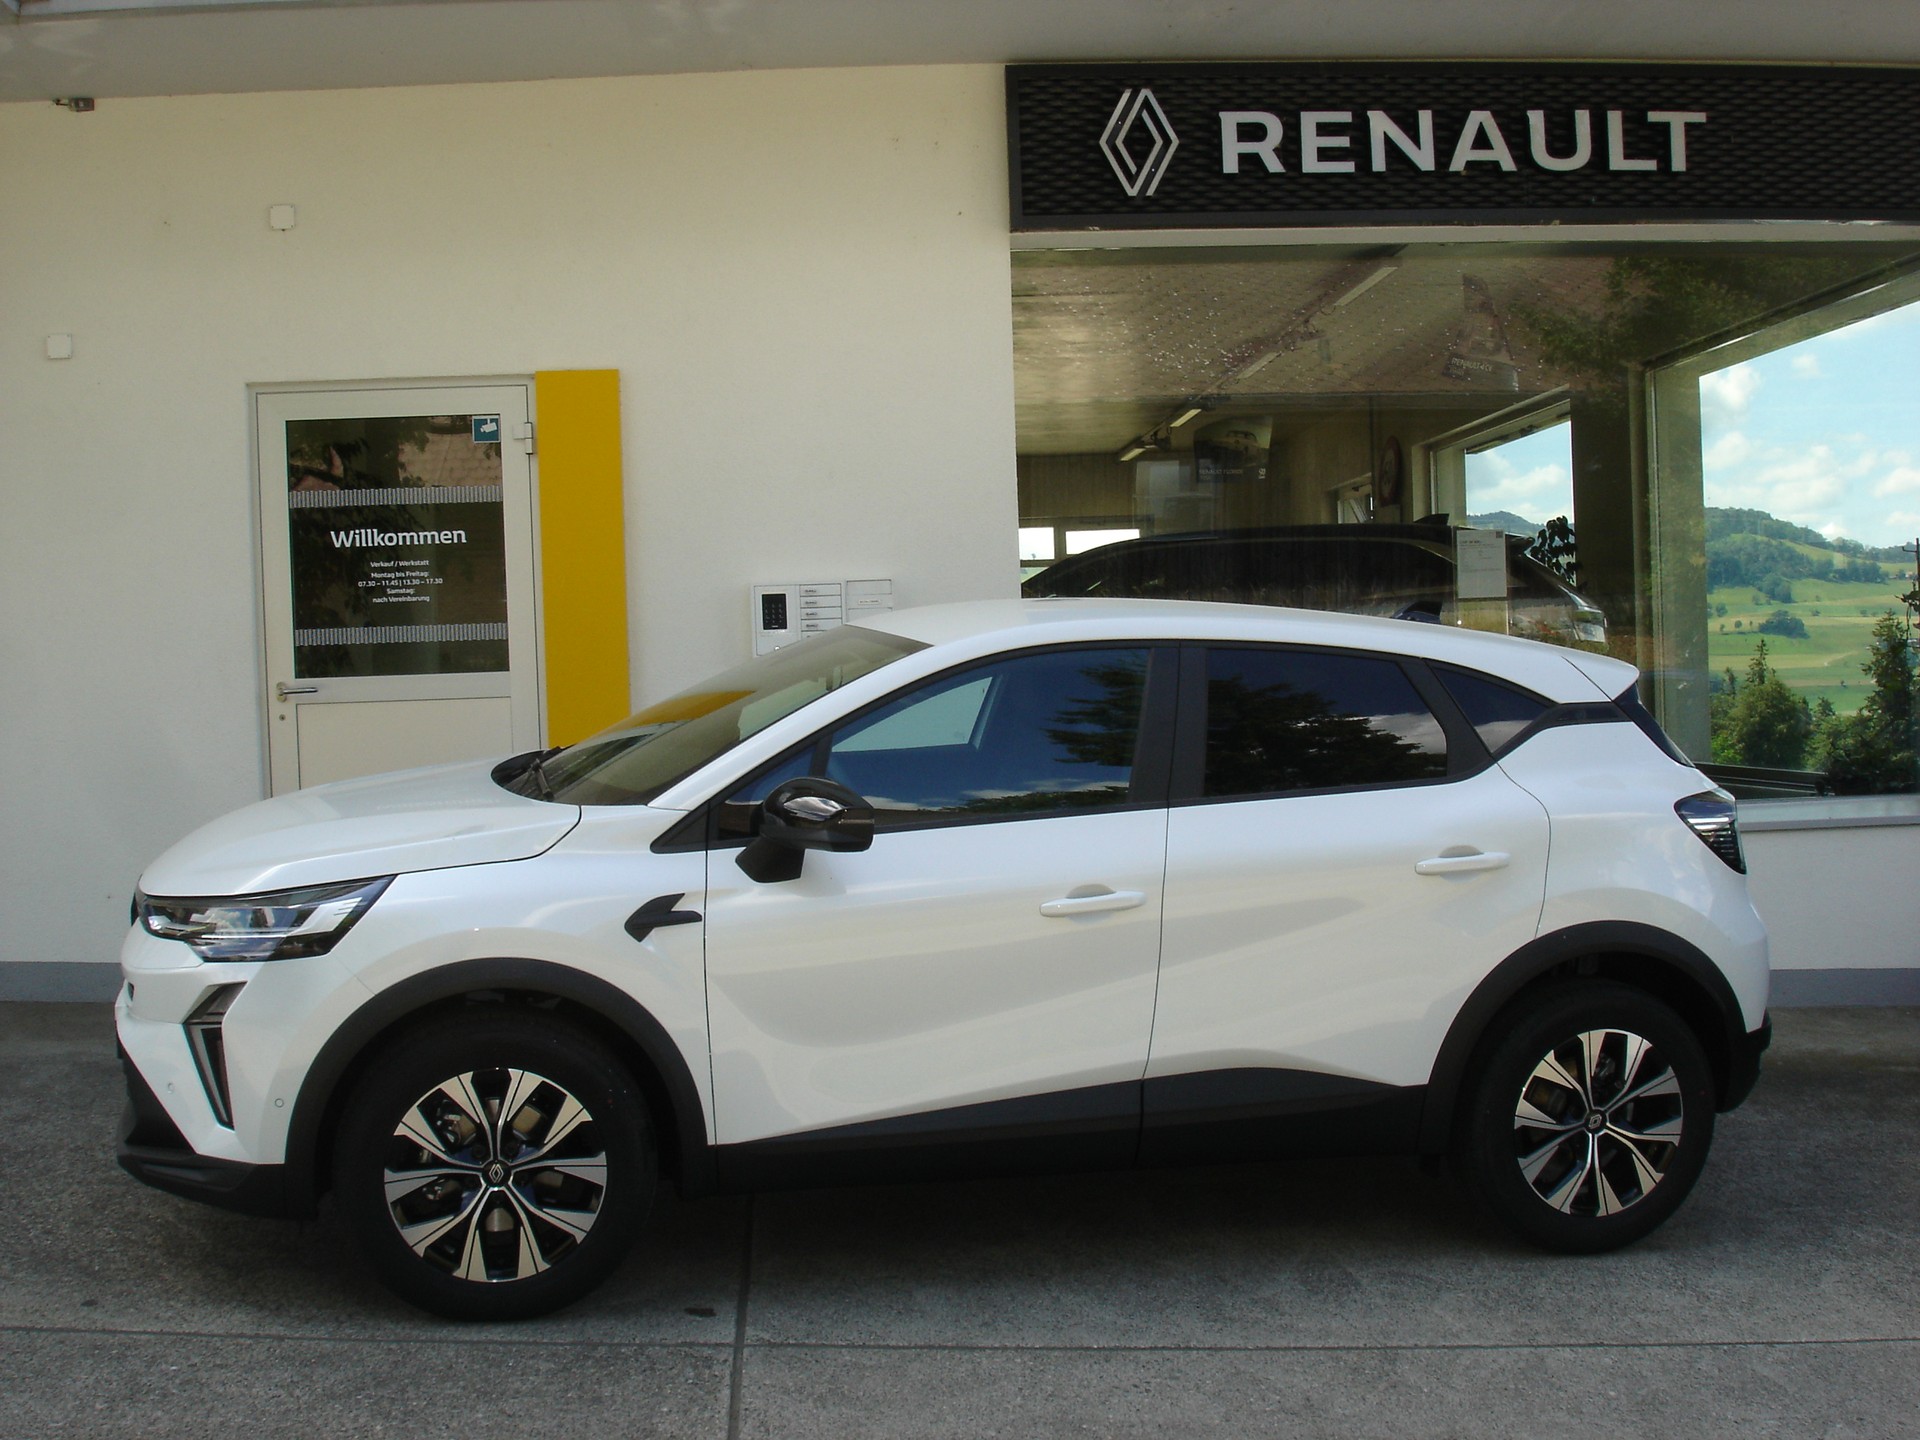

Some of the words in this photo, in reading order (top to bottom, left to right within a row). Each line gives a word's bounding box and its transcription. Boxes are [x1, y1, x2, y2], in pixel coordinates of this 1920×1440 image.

[1219, 109, 1706, 175] RENAULT
[330, 528, 467, 548] Willkommen
[389, 595, 430, 603] Vereinbarung
